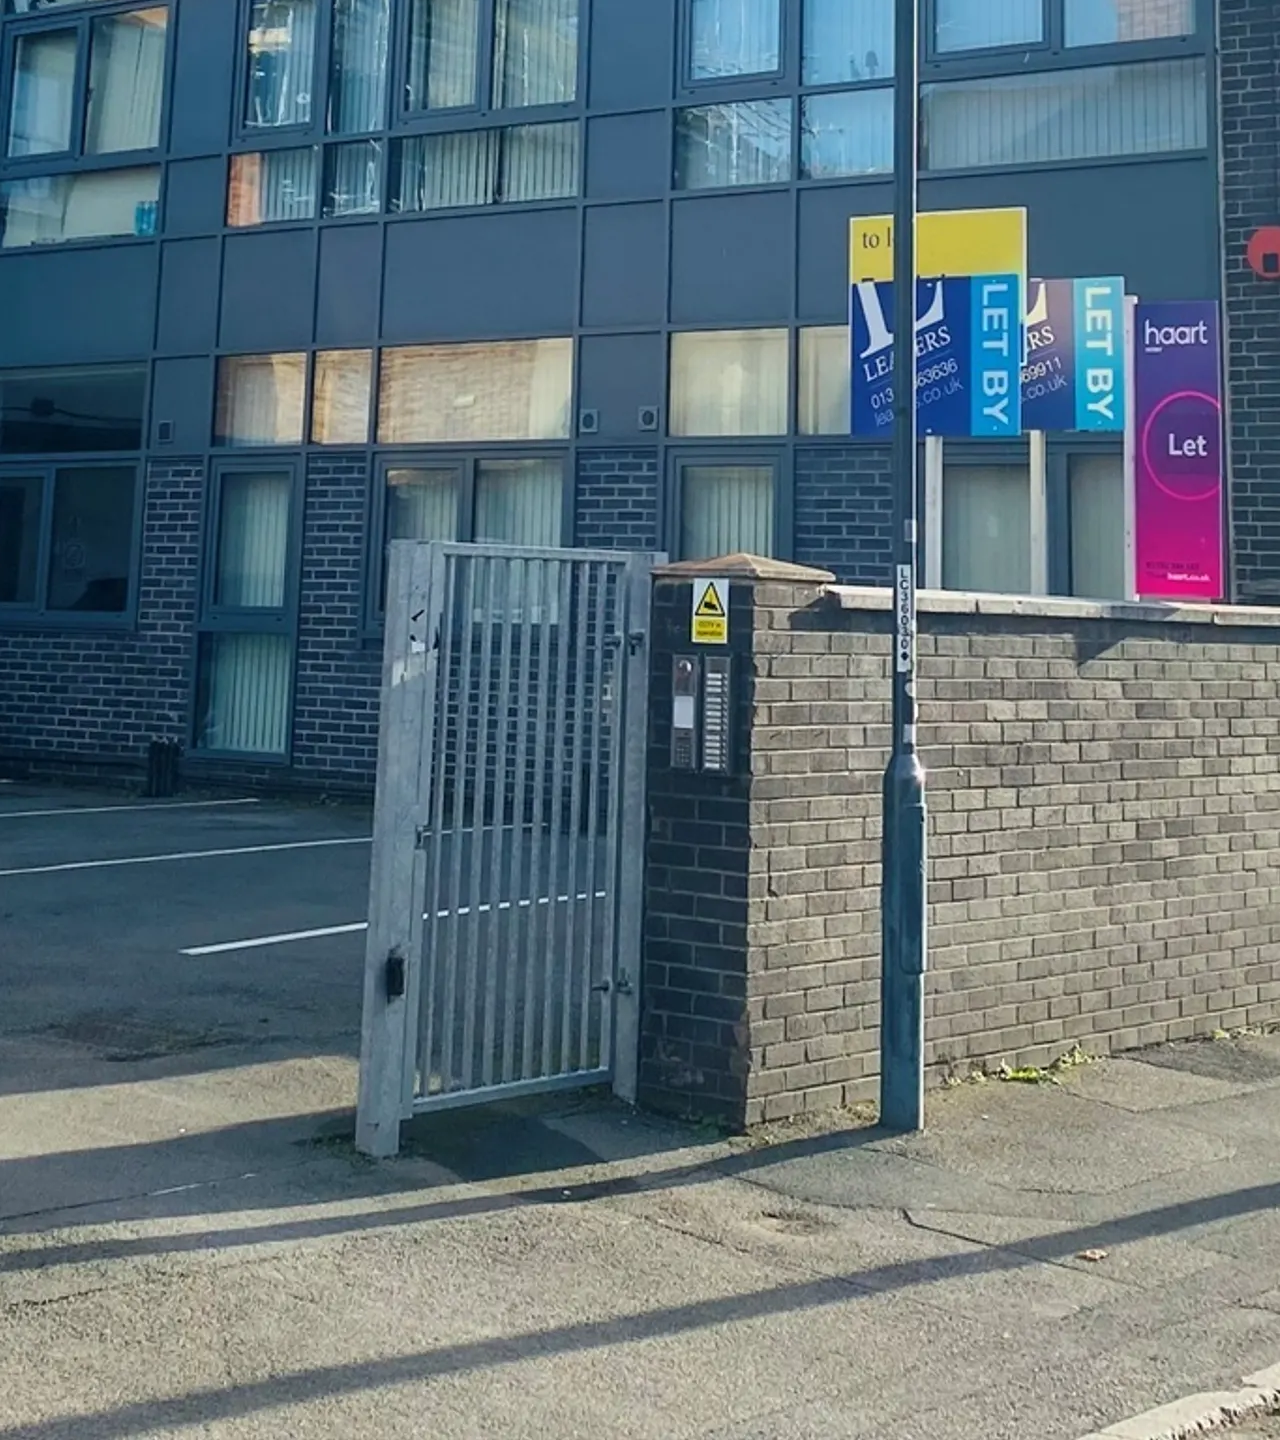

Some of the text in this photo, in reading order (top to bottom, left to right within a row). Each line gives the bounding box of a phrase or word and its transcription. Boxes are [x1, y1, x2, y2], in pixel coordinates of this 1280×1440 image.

[862, 231, 880, 249] to
[1144, 318, 1208, 345] haart
[982, 283, 1009, 425] LET BY
[1085, 286, 1114, 421] LET BY
[1168, 432, 1208, 457] Let
